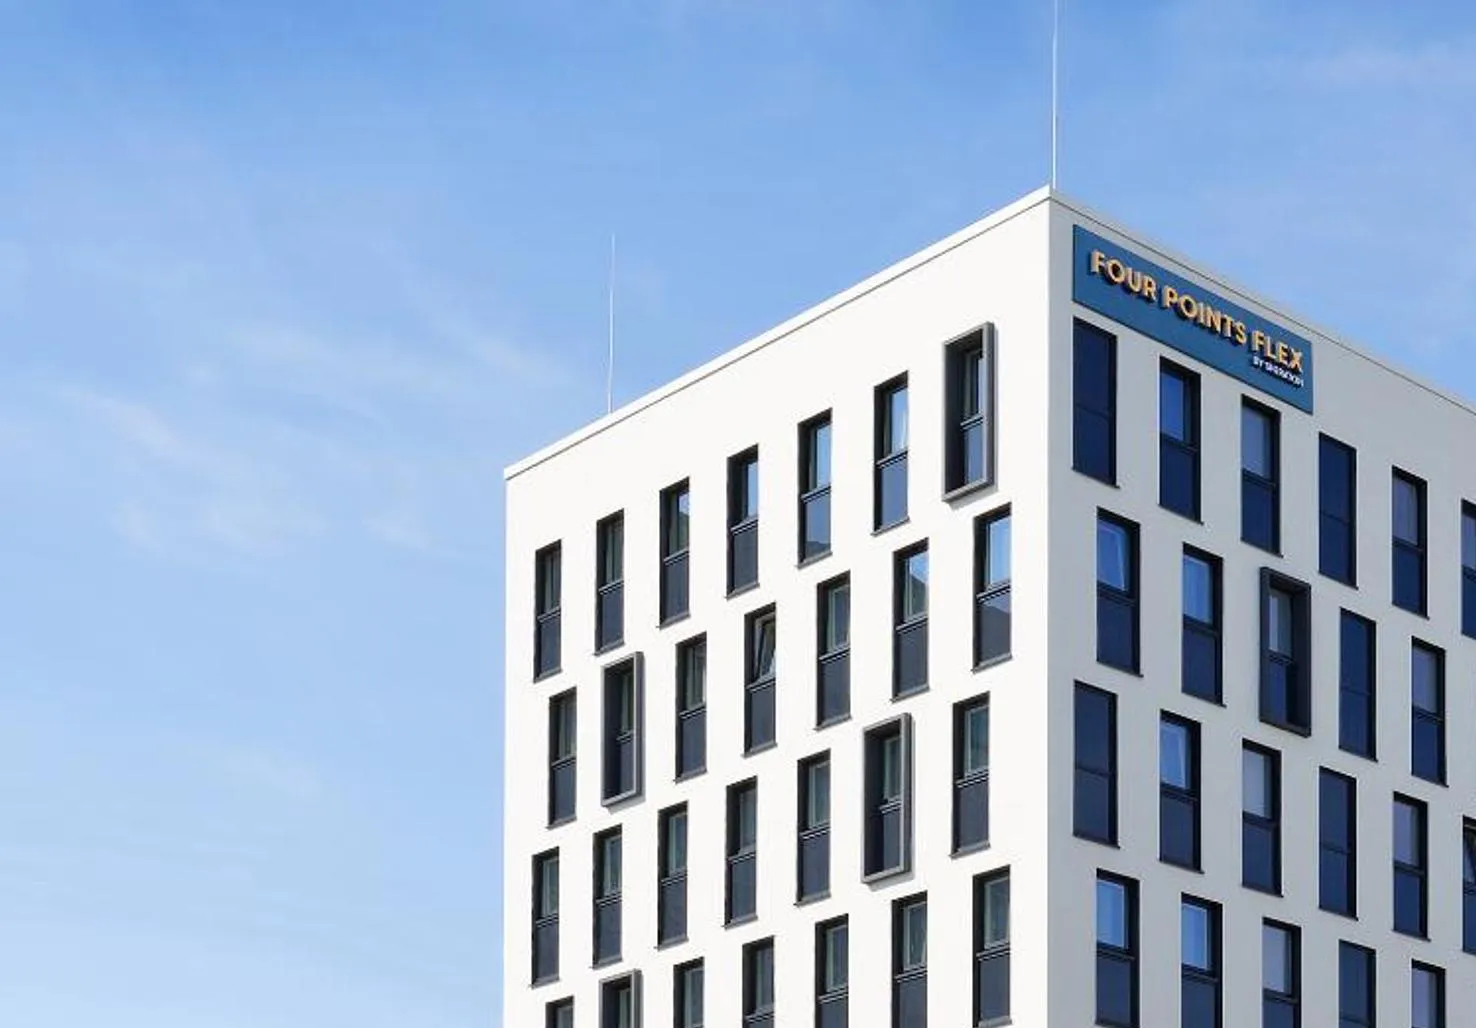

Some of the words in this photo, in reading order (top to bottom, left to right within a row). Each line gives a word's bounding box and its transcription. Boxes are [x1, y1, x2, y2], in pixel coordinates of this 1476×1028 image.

[1091, 250, 1156, 300] FOUR
[1163, 284, 1247, 344] POINTS
[1252, 329, 1303, 372] FLEX
